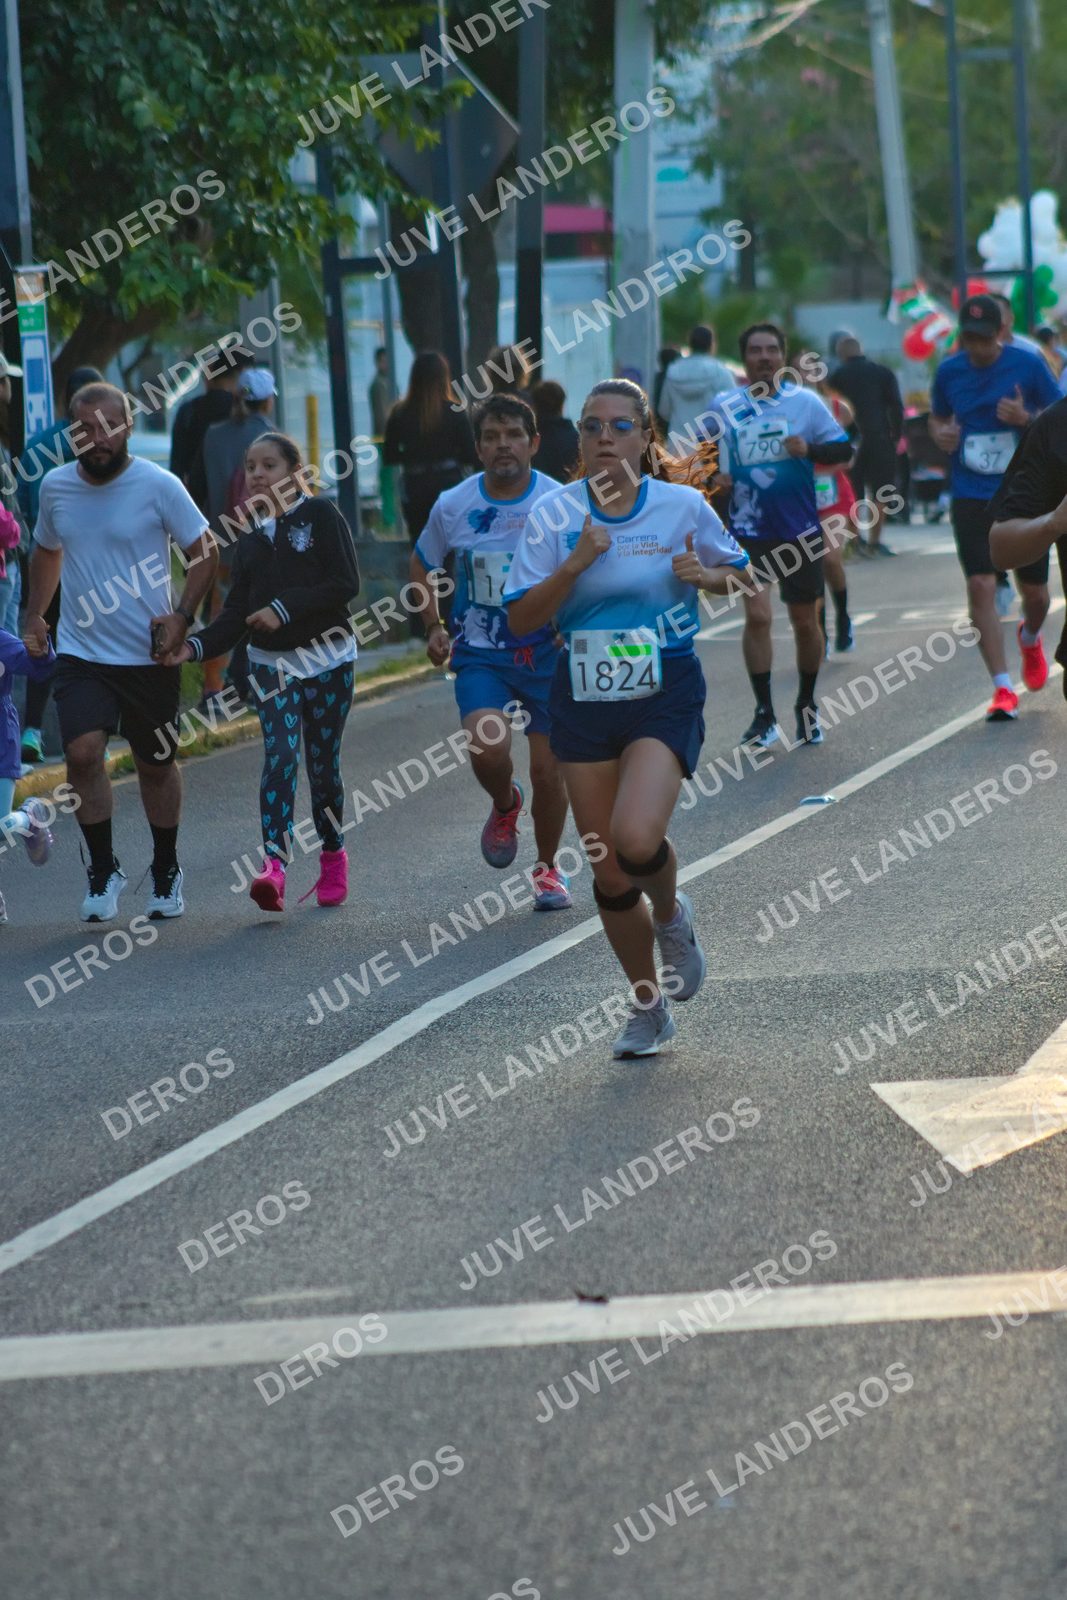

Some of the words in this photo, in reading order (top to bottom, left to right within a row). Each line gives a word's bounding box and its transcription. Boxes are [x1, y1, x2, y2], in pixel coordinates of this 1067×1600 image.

[746, 439, 781, 459] 790
[616, 534, 658, 543] Carrera
[632, 546, 672, 556] Integridad
[577, 660, 657, 692] 1824
